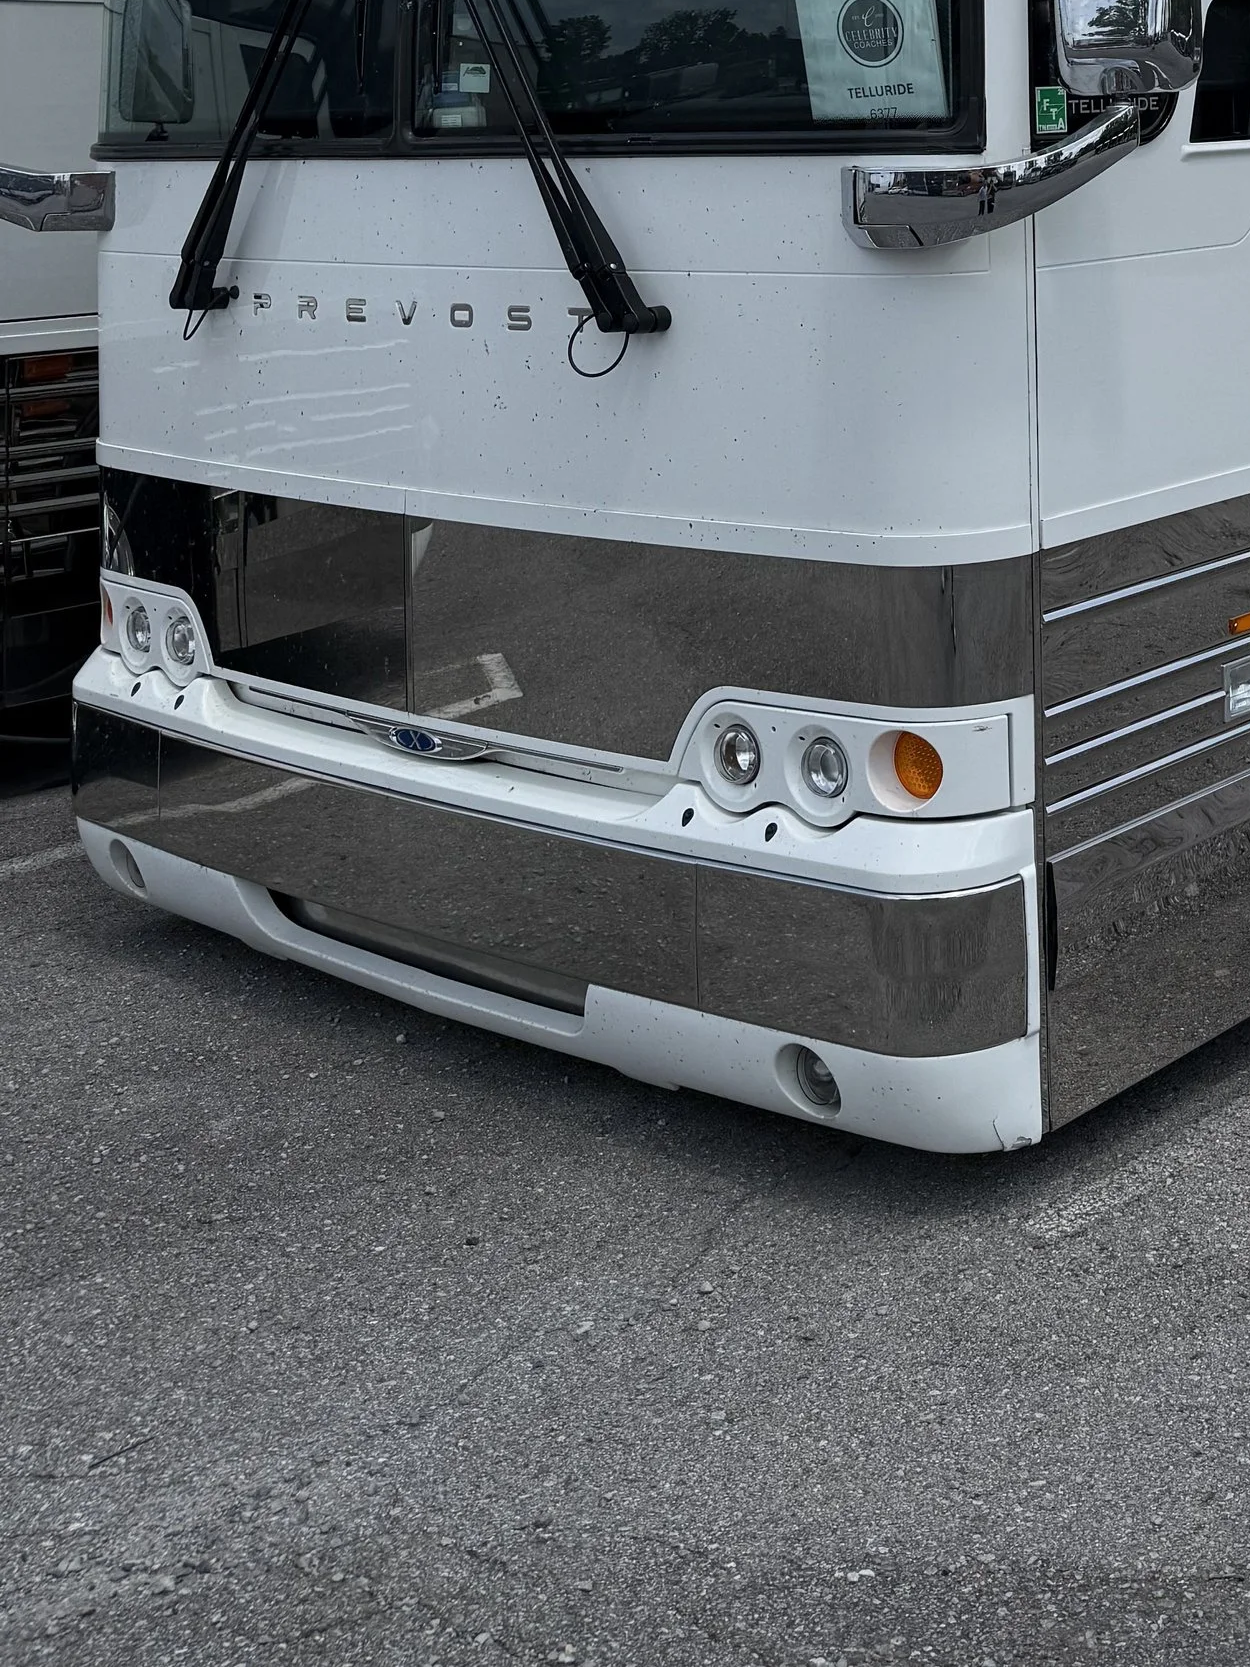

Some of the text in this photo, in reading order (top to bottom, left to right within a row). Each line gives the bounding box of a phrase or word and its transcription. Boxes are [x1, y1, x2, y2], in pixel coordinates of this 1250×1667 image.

[845, 26, 897, 42] CELEBRITY
[853, 38, 893, 49] COACHES
[847, 82, 915, 100] TELLURIDE
[869, 106, 898, 120] 6377
[1068, 96, 1160, 115] TELLIDE
[252, 291, 594, 334] PREVOST
